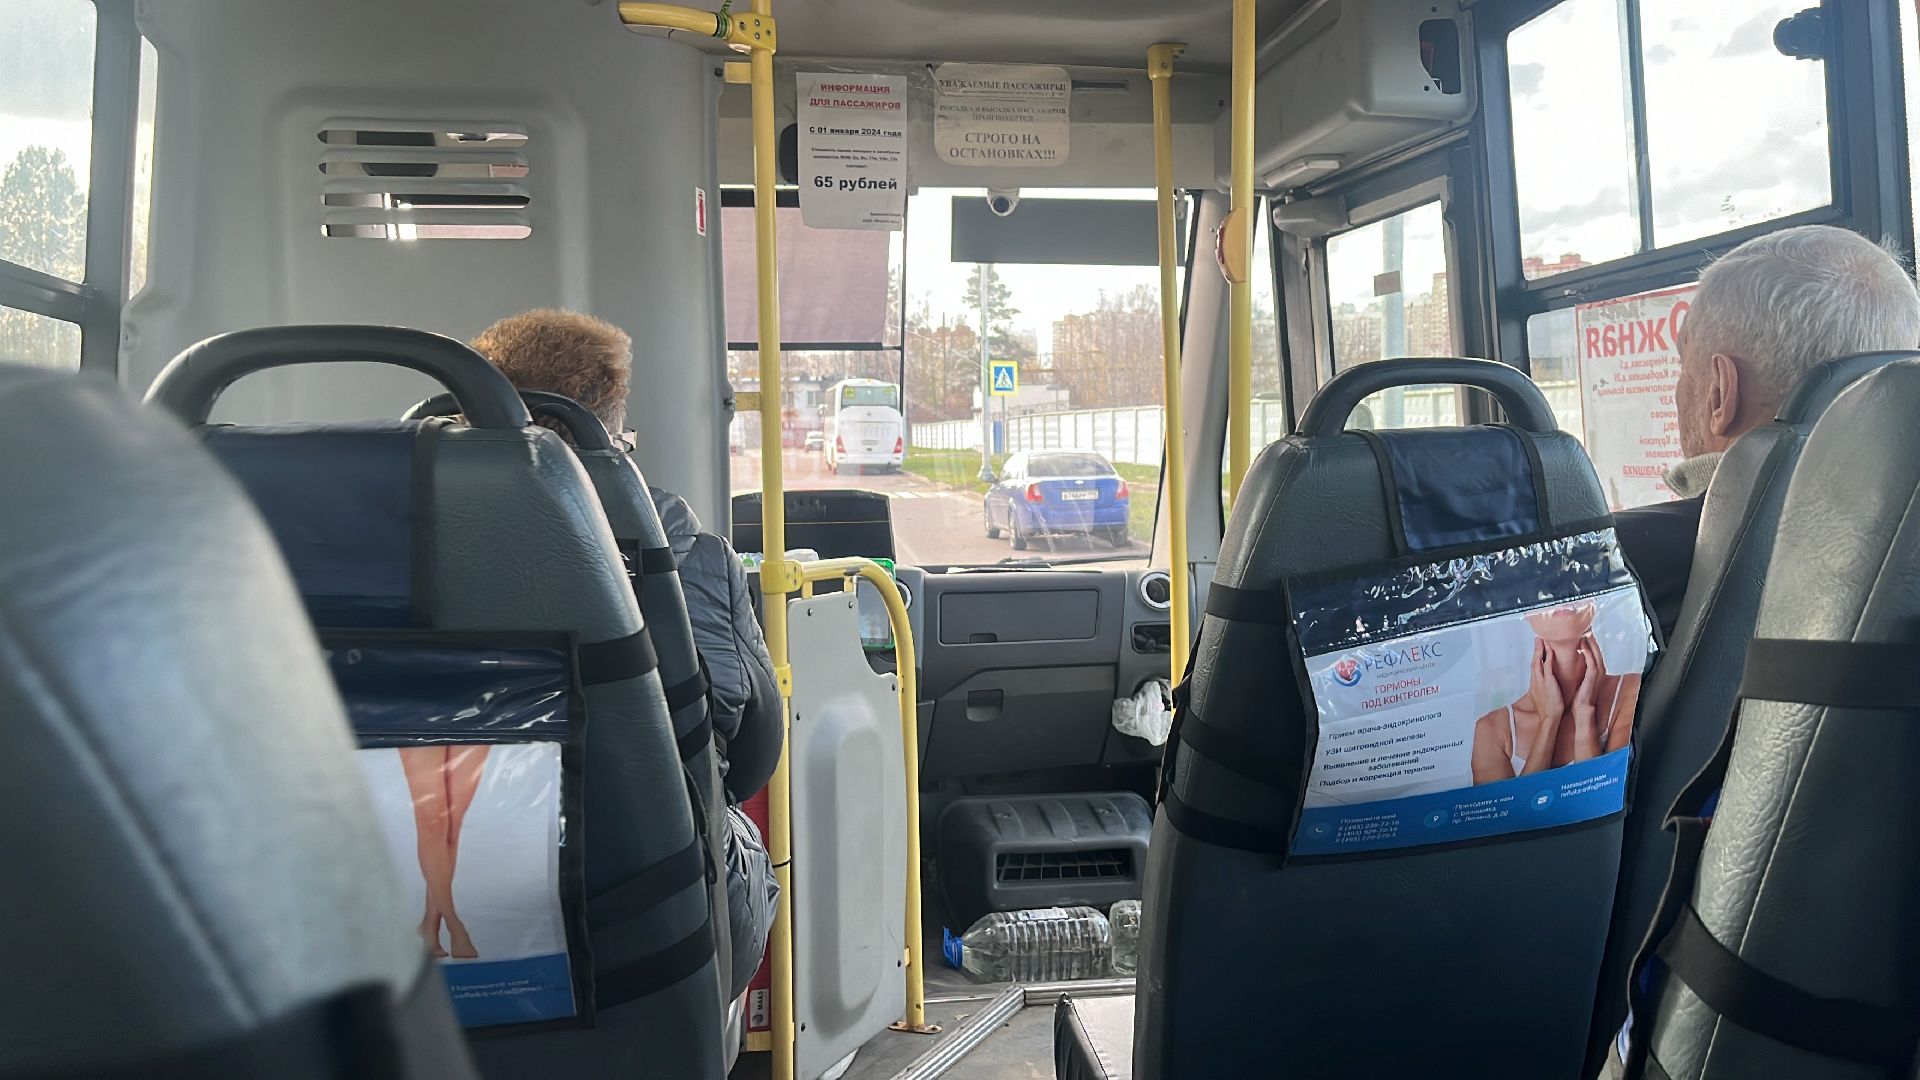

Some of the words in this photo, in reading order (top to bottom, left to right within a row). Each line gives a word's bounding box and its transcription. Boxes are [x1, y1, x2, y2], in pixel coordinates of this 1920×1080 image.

[820, 84, 890, 93] ИНФОРМАЦИЯ
[940, 80, 1000, 89] УВАЖАЕМЫЕ
[810, 98, 830, 107] ДЛЯ
[833, 100, 901, 109] ПАССАЖИРОВ
[965, 132, 1018, 144] СТРОГО
[1022, 134, 1041, 144] НА
[950, 148, 1056, 160] ОСТАНОВКАХ!!!
[814, 175, 833, 187] 65
[839, 177, 897, 191] рублей
[1365, 642, 1442, 671] РЕФЛЕКС
[1375, 678, 1421, 694] ГОРМОНЫ
[1362, 698, 1382, 710] ПОД
[1383, 685, 1440, 705] КОНТРОЛЕМ
[1329, 730, 1356, 741] Прием
[1357, 711, 1442, 735] врача-эндокринолога
[1325, 747, 1342, 756] УЗИ
[1343, 738, 1394, 753] щитовидной
[1395, 732, 1426, 744] железы
[1323, 758, 1369, 771] Выявление
[1377, 750, 1411, 763] лечение
[1411, 739, 1465, 757] эндокринных
[1368, 757, 1419, 771] заболеваний
[1319, 777, 1350, 787] Подбор
[1358, 769, 1402, 783] коррекция
[1403, 764, 1435, 775] терапии
